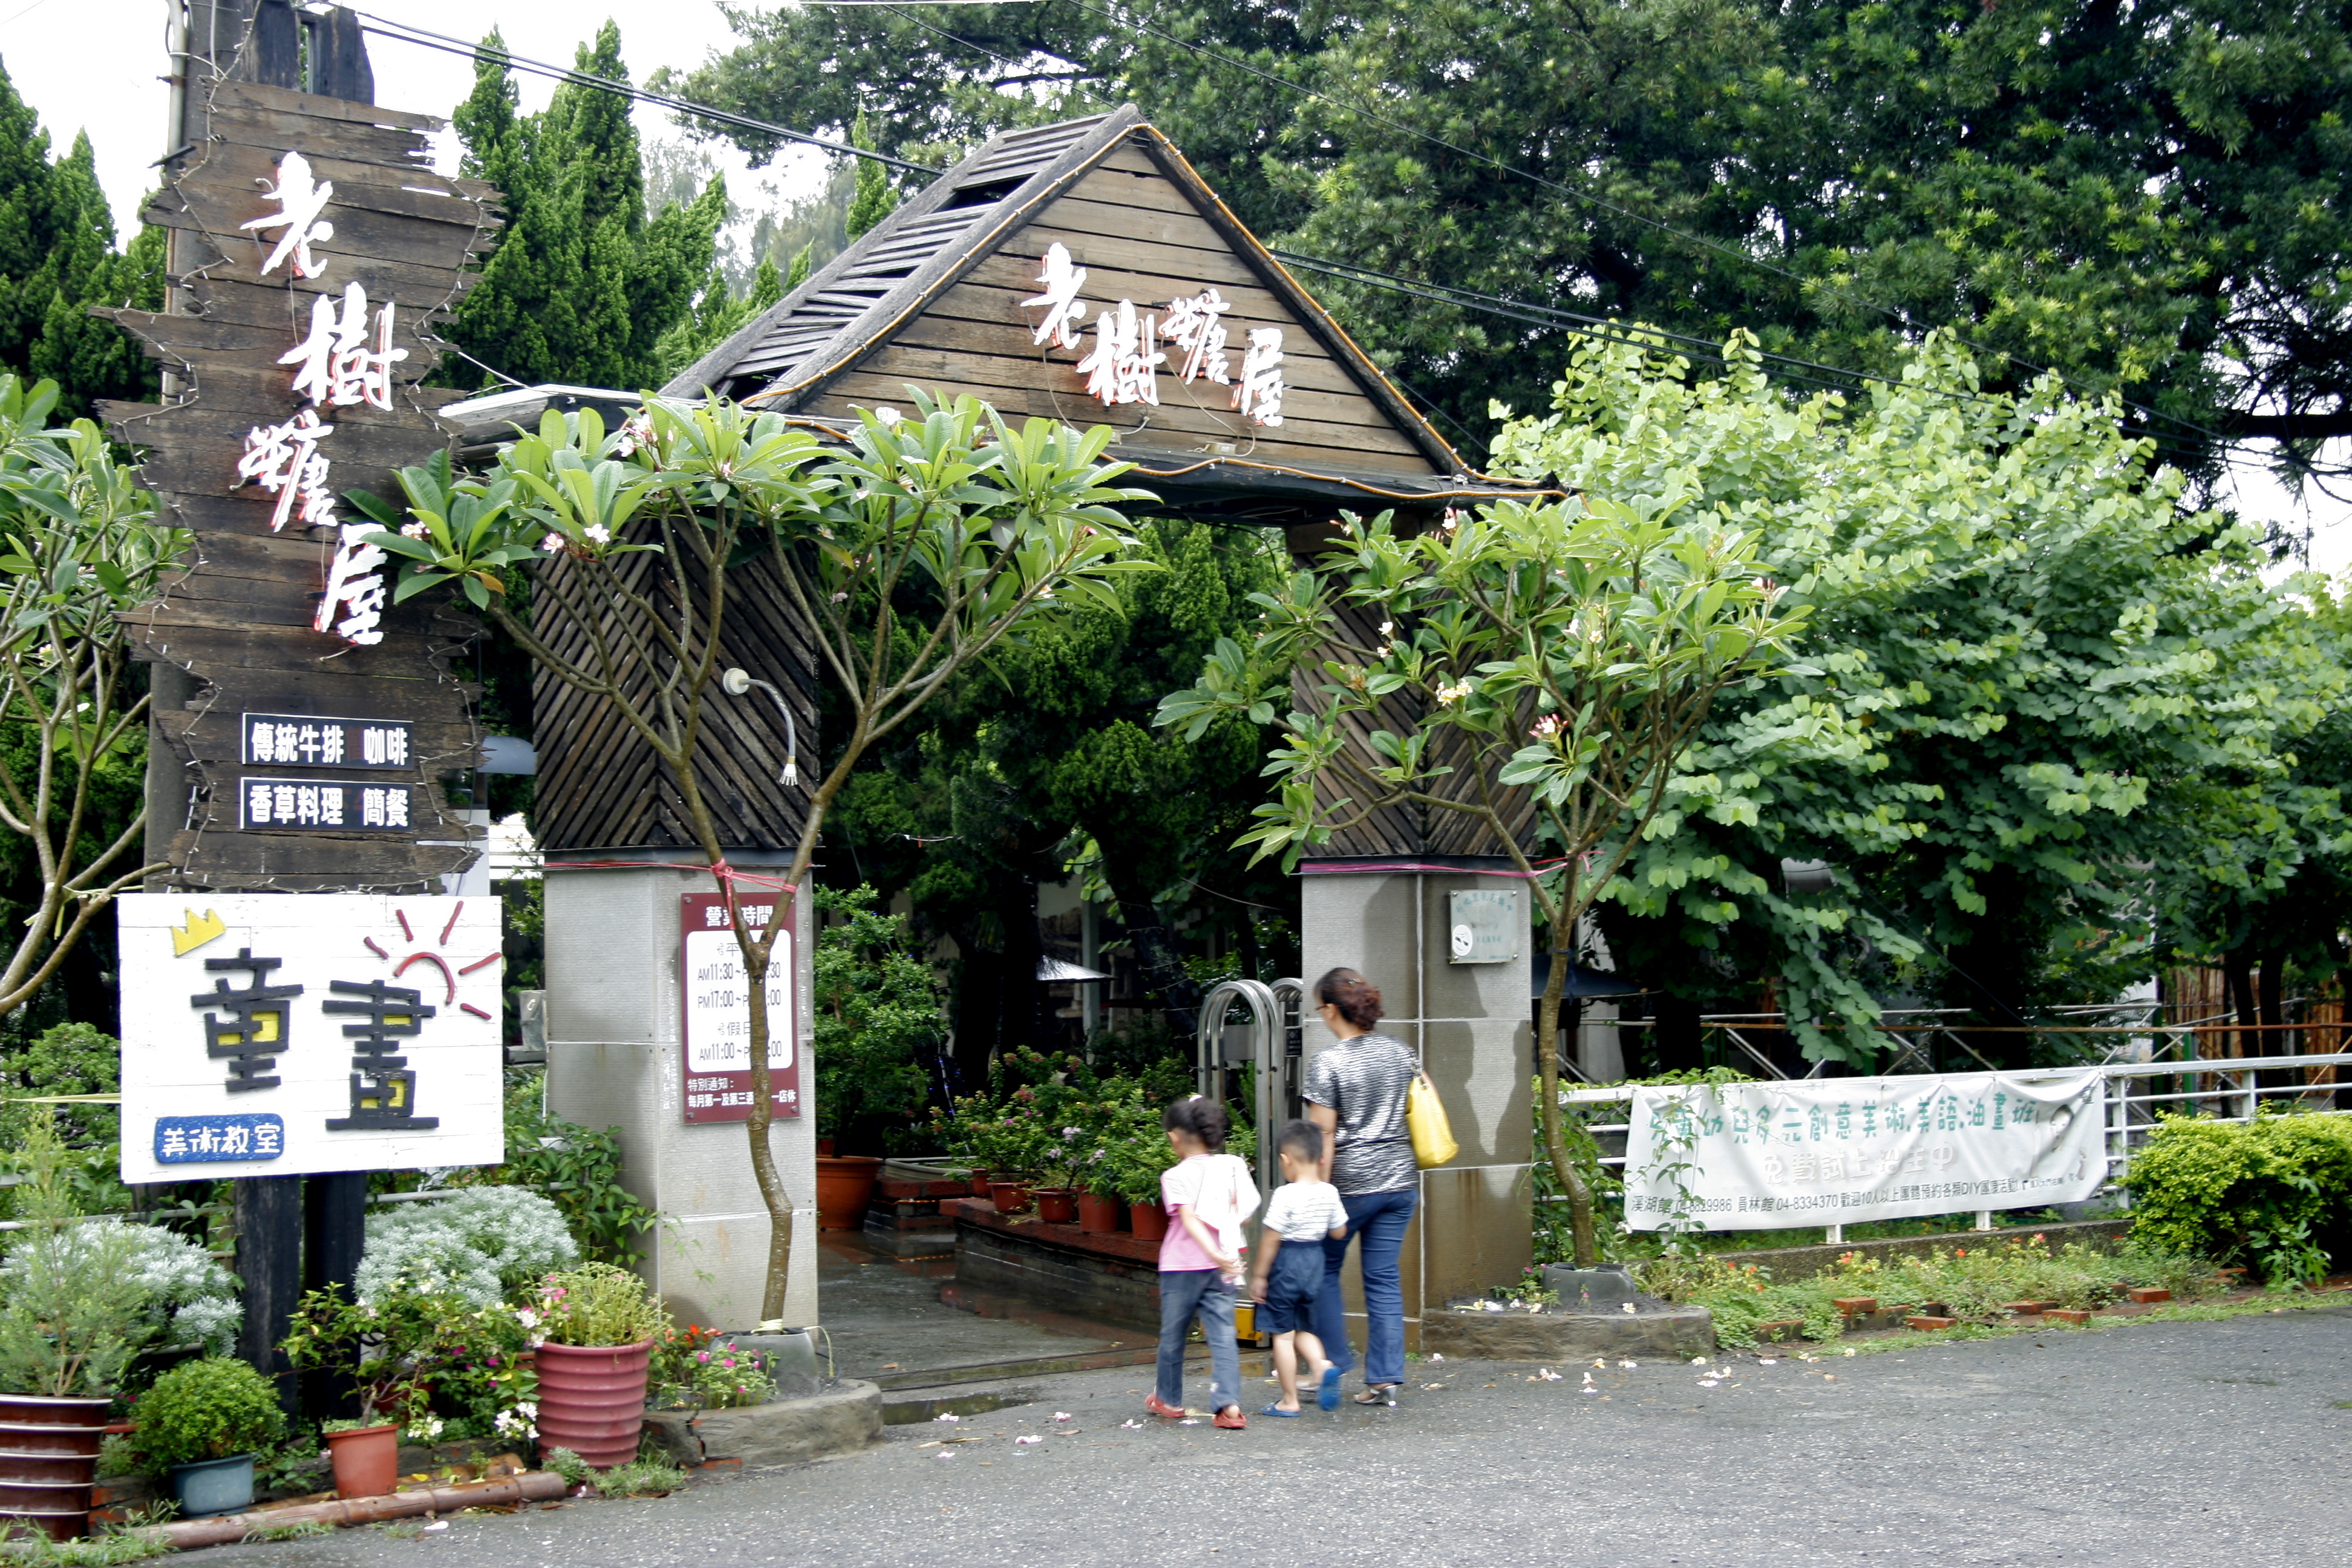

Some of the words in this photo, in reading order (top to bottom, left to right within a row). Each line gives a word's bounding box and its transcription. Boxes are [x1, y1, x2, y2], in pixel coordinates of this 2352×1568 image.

[252, 722, 344, 763] 傳統牛排
[364, 727, 408, 766] 咖啡
[250, 785, 343, 825] 香草料理
[363, 788, 408, 826] 簡餐
[163, 1123, 281, 1156] 美術教室
